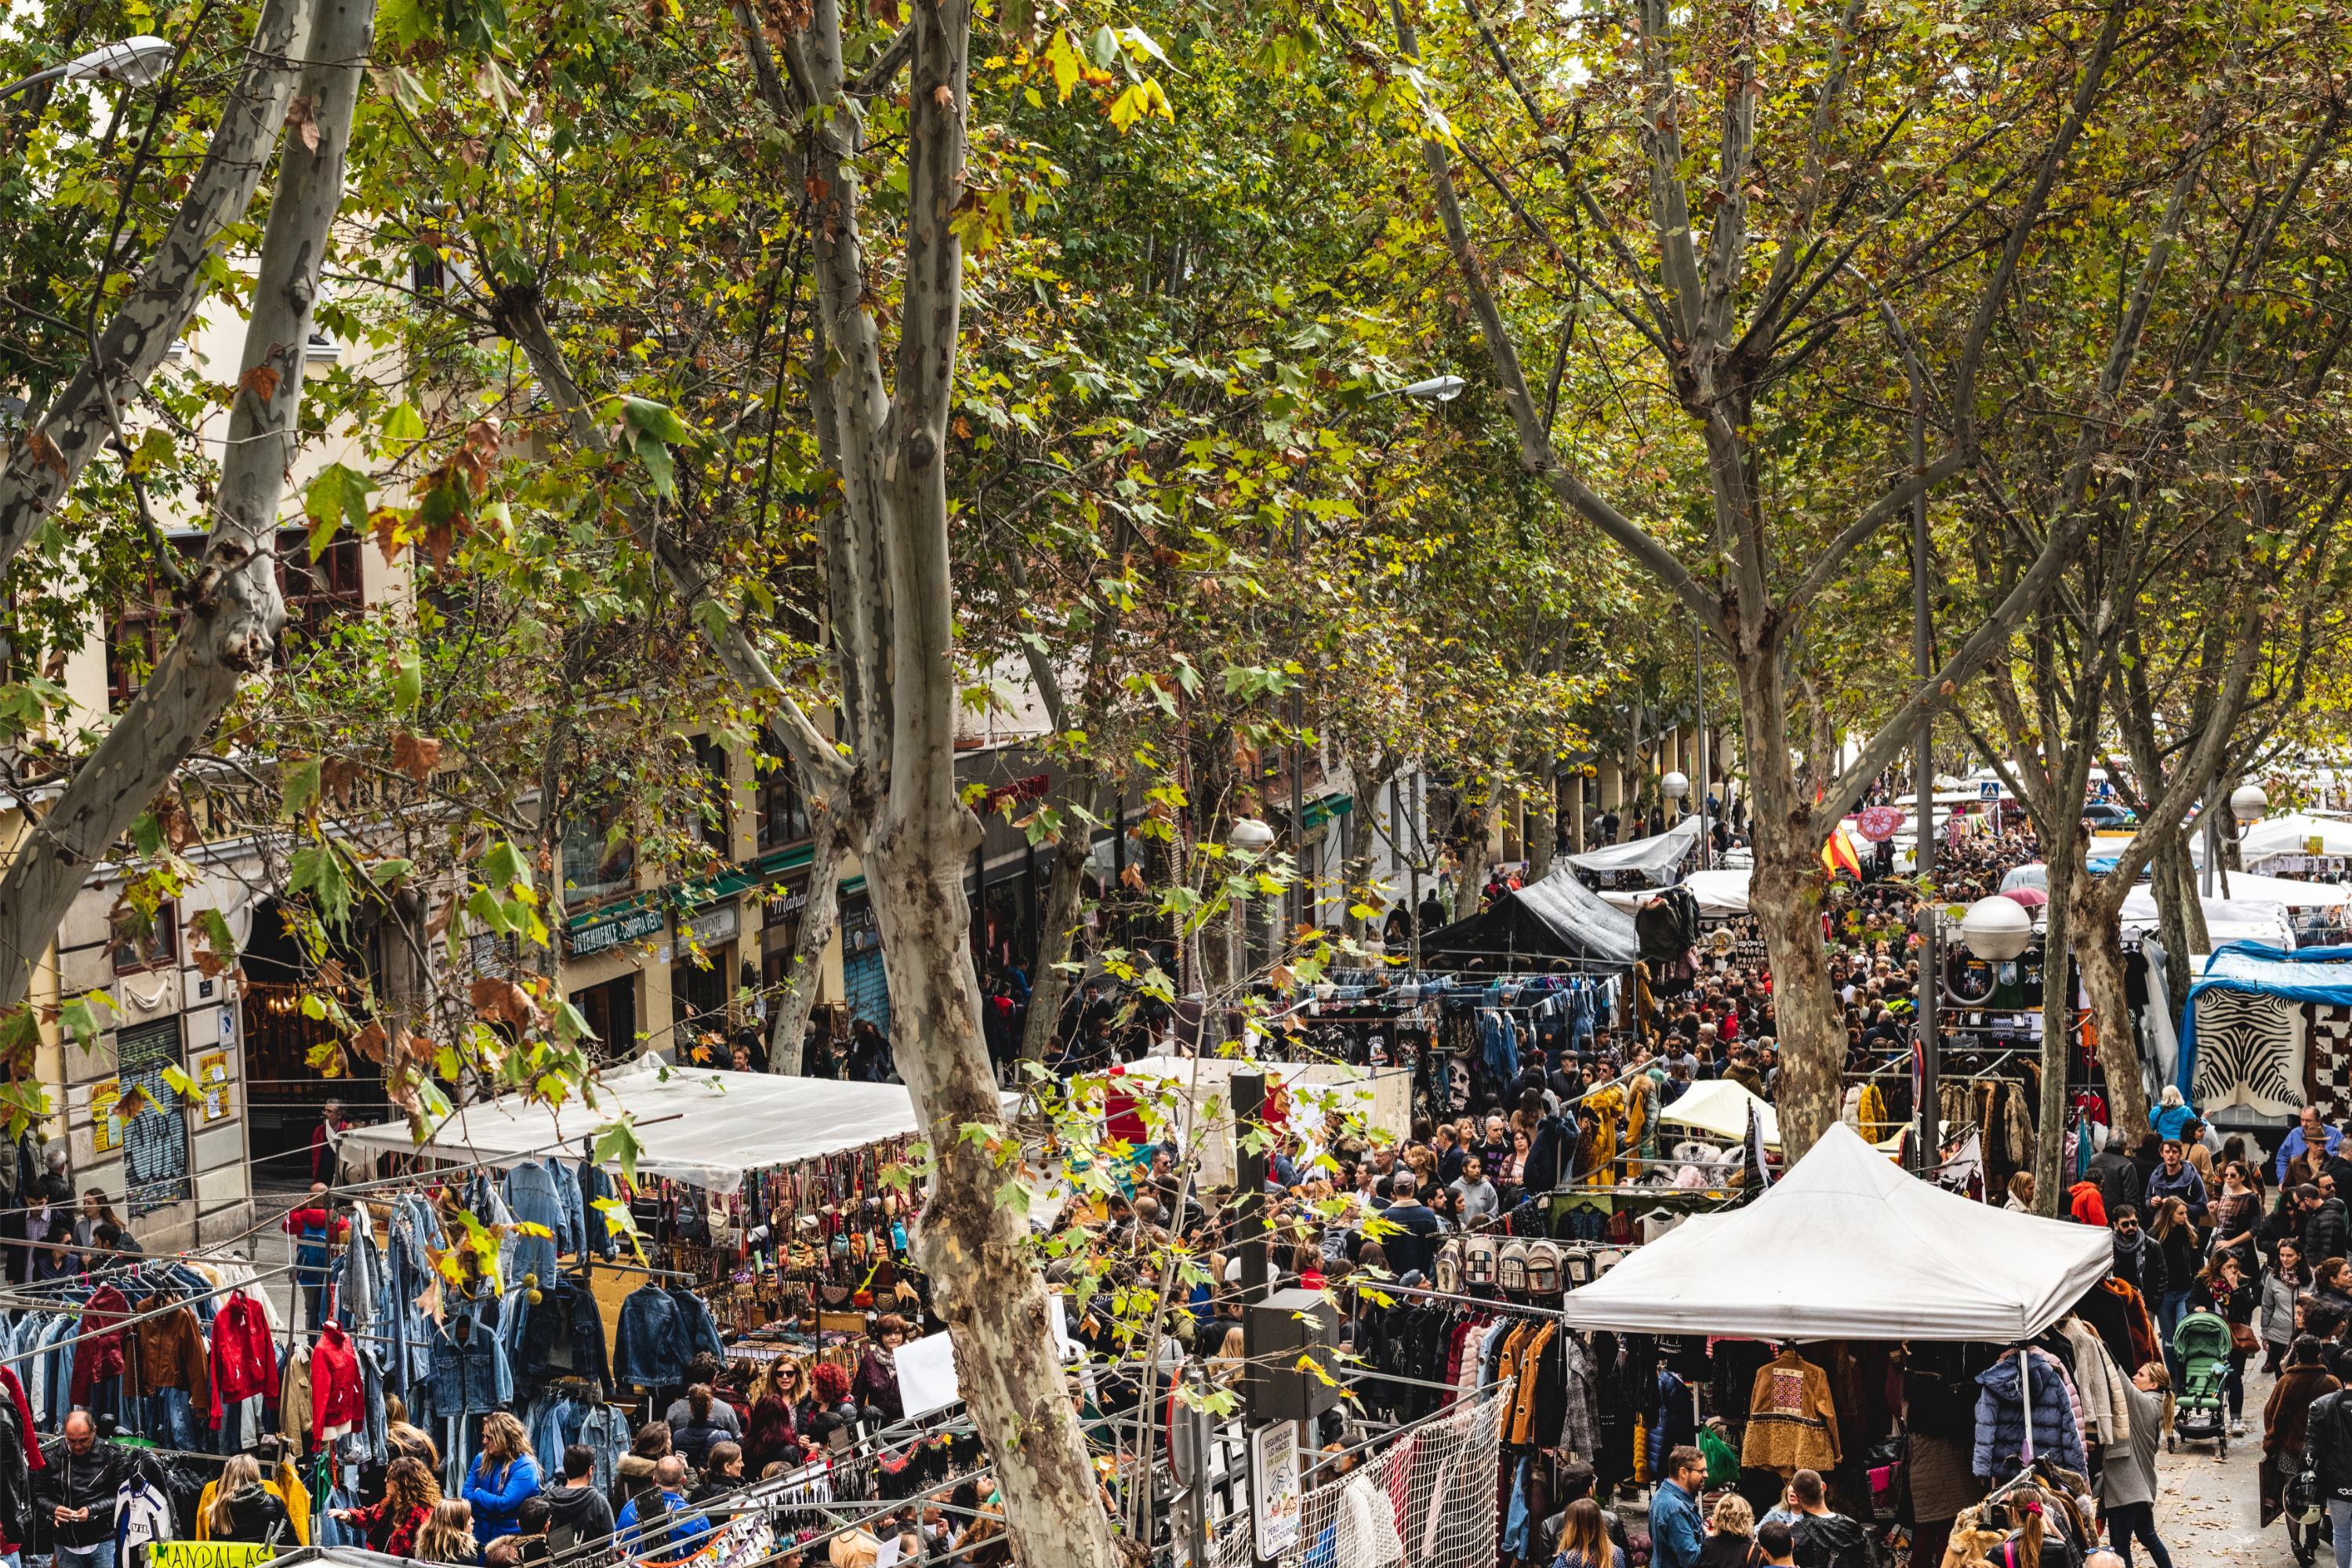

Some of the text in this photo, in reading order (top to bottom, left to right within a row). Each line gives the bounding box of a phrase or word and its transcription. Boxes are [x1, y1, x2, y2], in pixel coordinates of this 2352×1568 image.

[1265, 1428, 1293, 1449] SEGURO QUE
[1269, 1439, 1290, 1457] LO HACES
[1275, 1448, 1293, 1464] QUERER
[1268, 1514, 1296, 1537] PERO QUIERE
[1279, 1524, 1296, 1539] CIUDAD
[155, 1545, 270, 1568] MANDALAS
